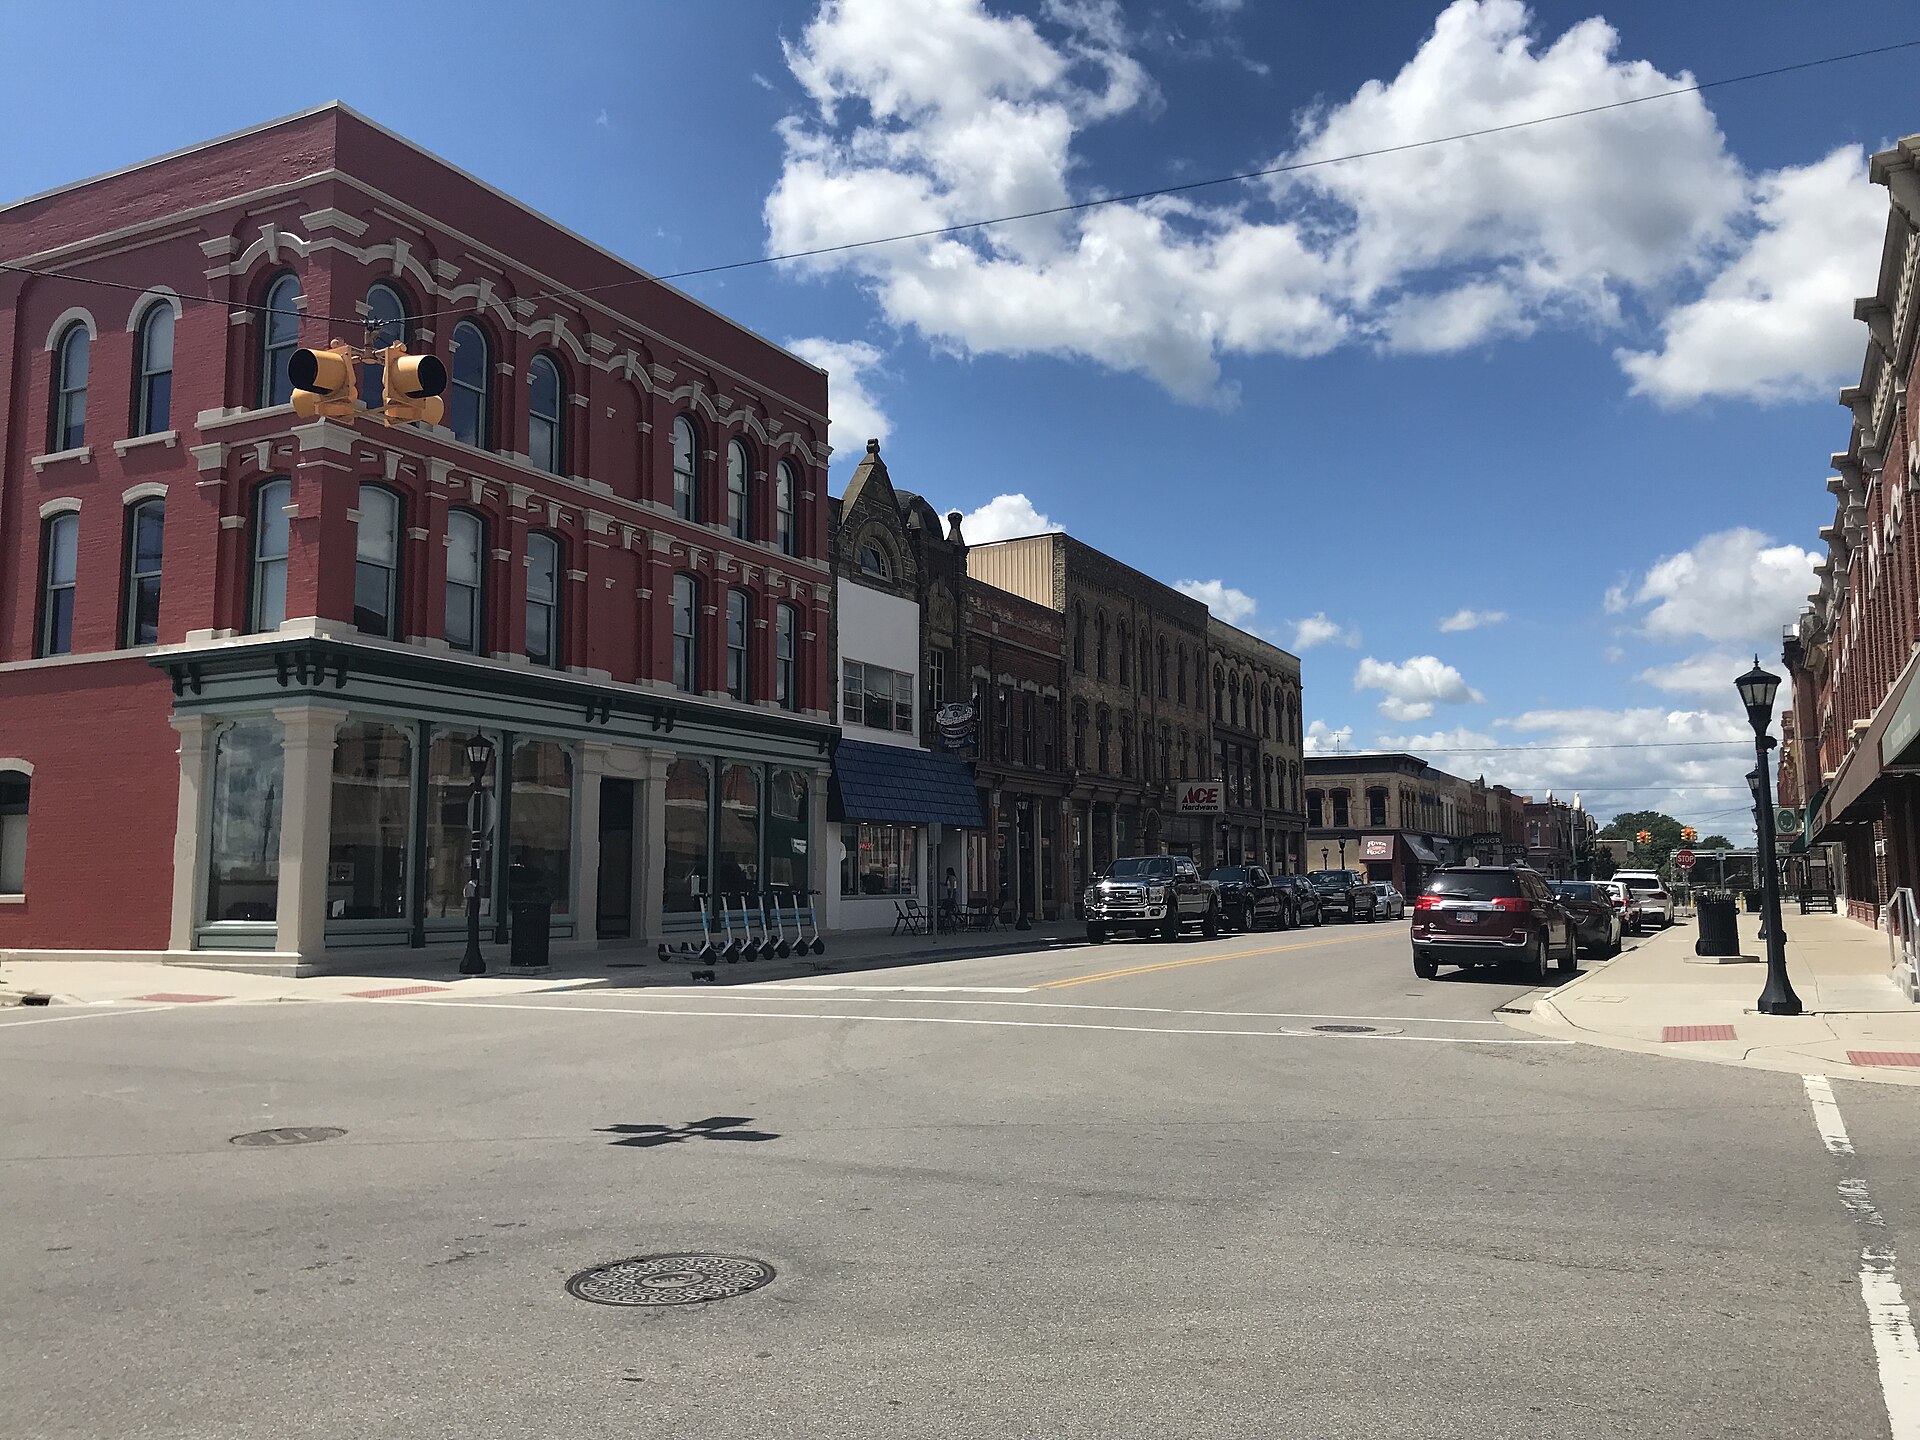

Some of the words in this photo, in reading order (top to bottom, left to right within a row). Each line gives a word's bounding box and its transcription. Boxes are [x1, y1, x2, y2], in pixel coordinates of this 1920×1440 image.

[1182, 786, 1218, 803] ACE
[1182, 803, 1218, 811] Hardware
[1677, 855, 1695, 863] STOP
